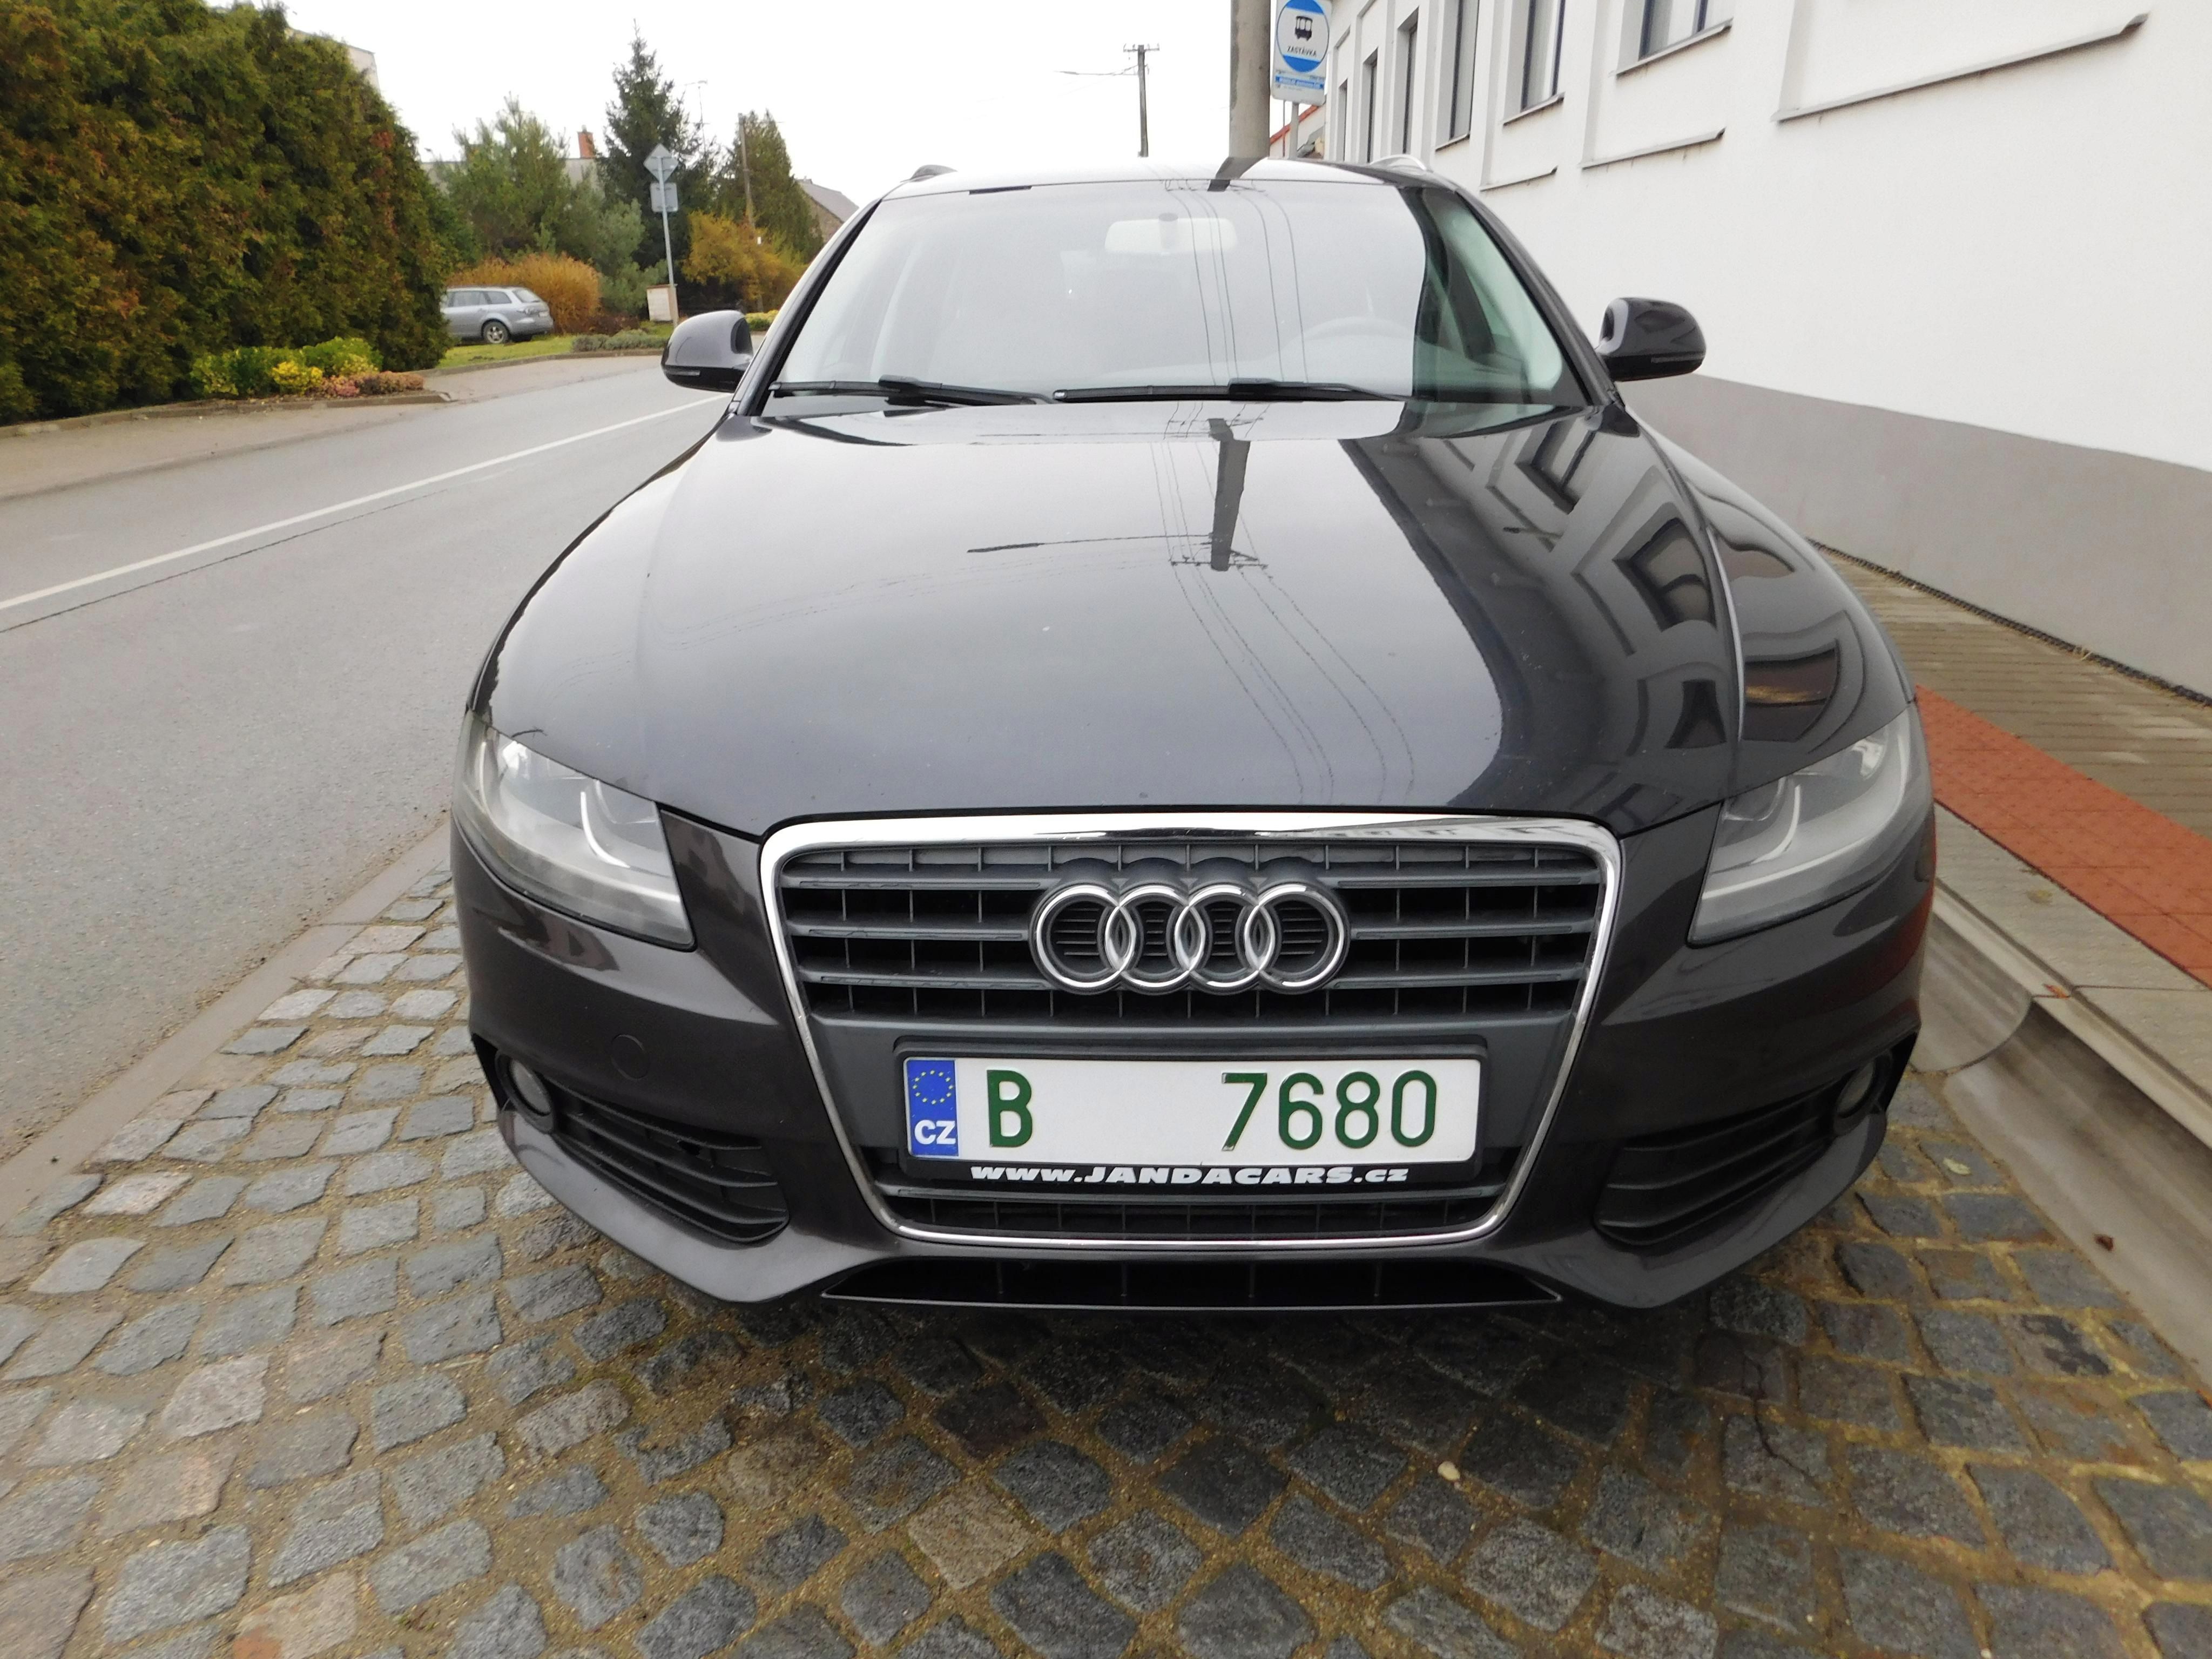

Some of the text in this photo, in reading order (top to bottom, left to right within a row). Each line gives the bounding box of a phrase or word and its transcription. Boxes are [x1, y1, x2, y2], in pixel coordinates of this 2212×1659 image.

[987, 1069, 1437, 1151] B 7680
[914, 1120, 956, 1145] CZ
[970, 1166, 1408, 1184] www.JANDACARS.cz
